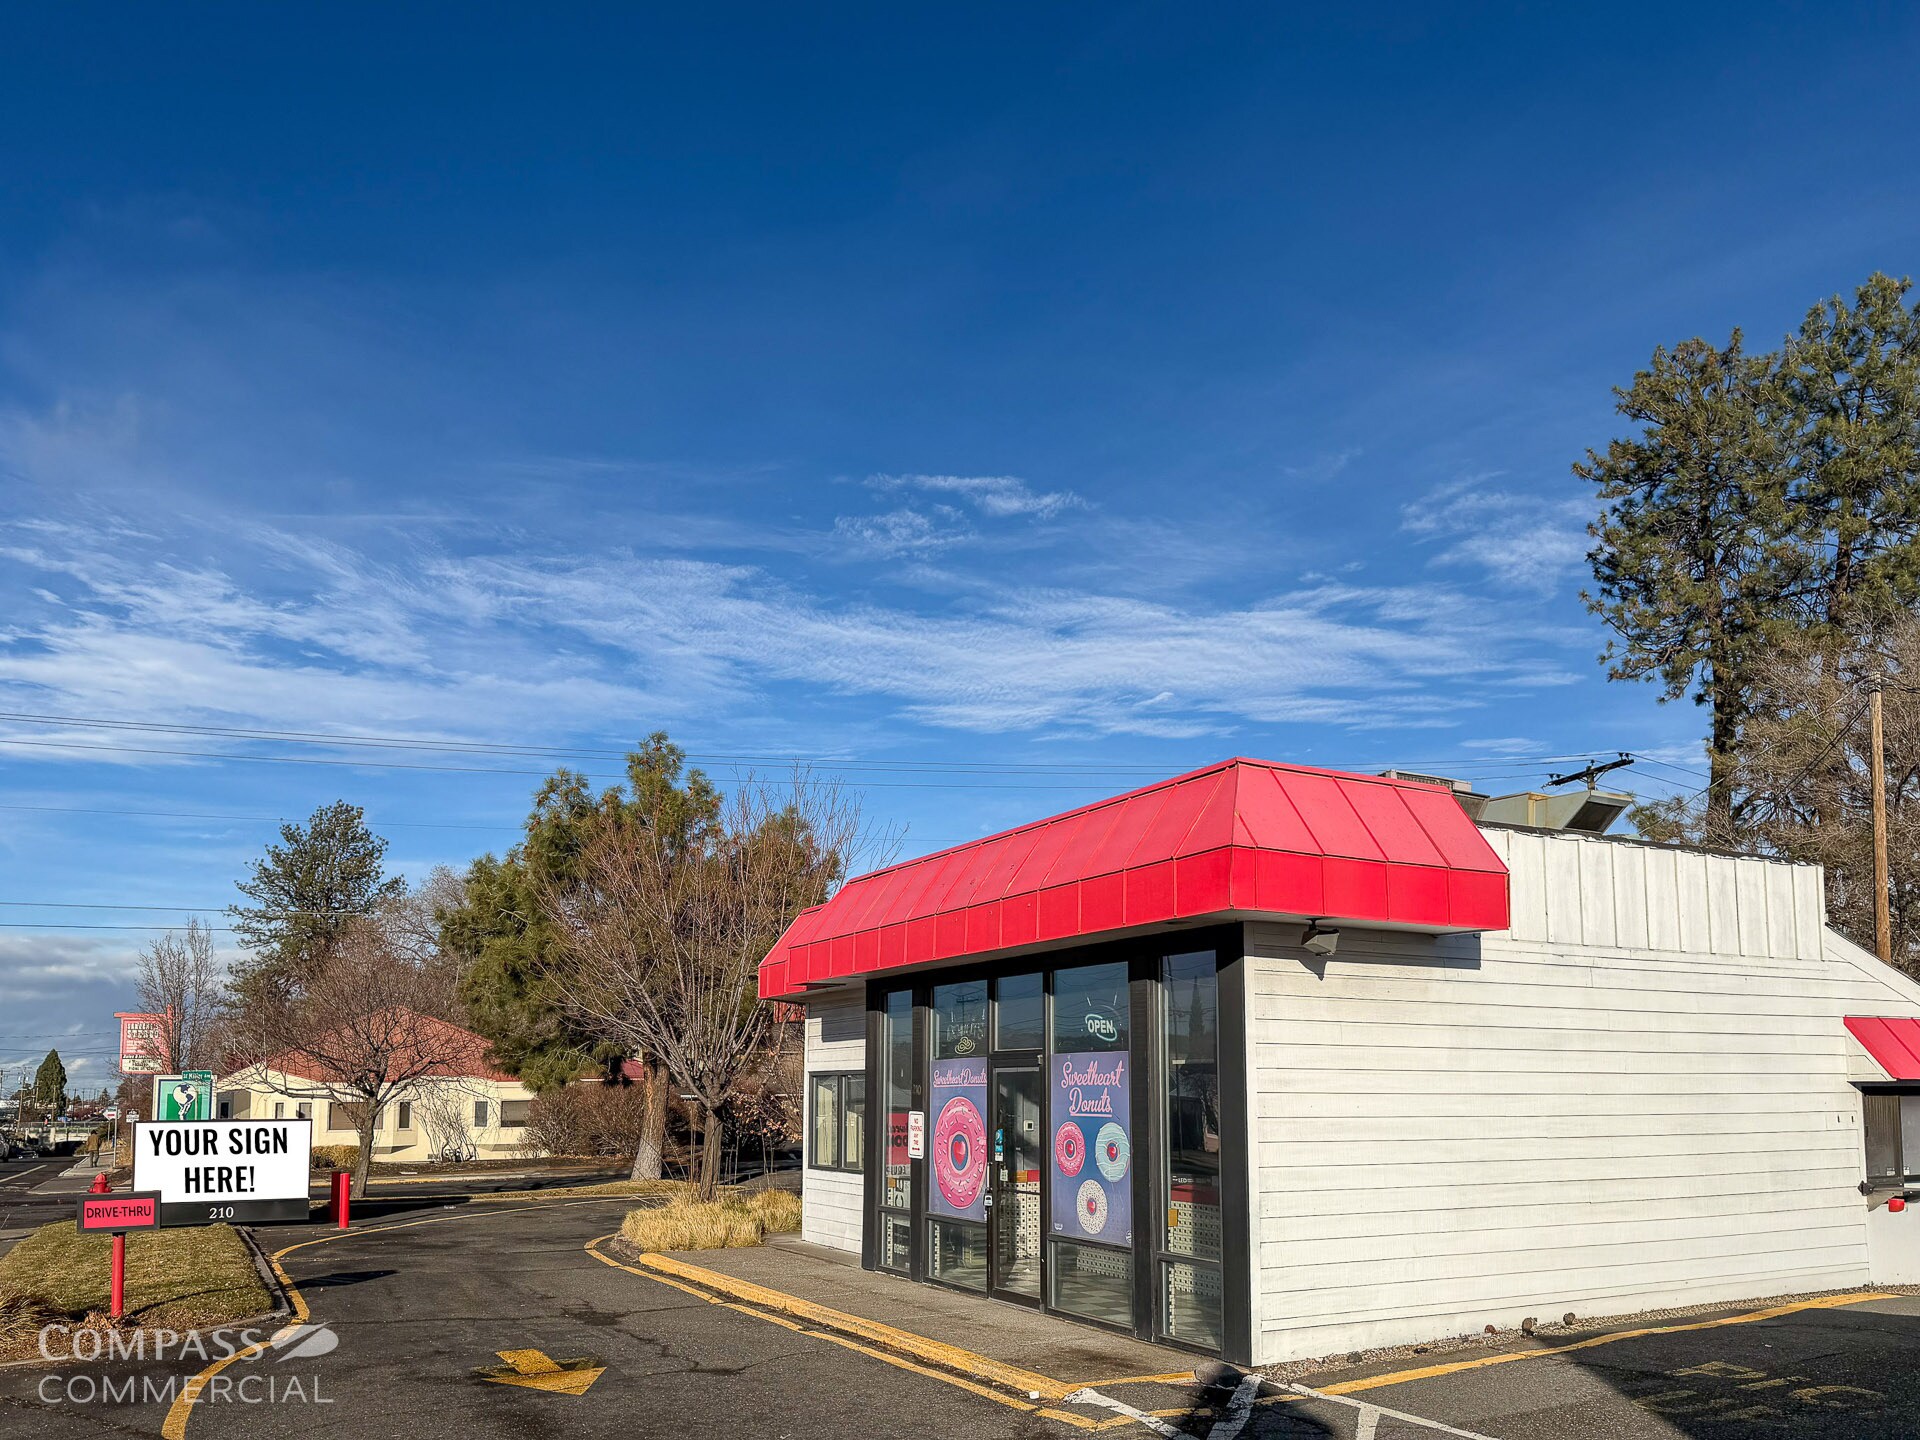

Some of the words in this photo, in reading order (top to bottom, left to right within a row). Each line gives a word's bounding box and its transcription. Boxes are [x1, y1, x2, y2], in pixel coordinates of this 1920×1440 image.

[1087, 1019, 1114, 1034] OPEN
[933, 1068, 964, 1086] Sweetheart
[1061, 1060, 1124, 1088] Sweetheart
[1069, 1087, 1113, 1116] Donuts
[149, 1129, 218, 1156] YOUR
[229, 1127, 288, 1155] SIGN
[184, 1166, 256, 1194] HERE!
[86, 1205, 151, 1219] DRIVE-THRU
[209, 1206, 234, 1219] 210
